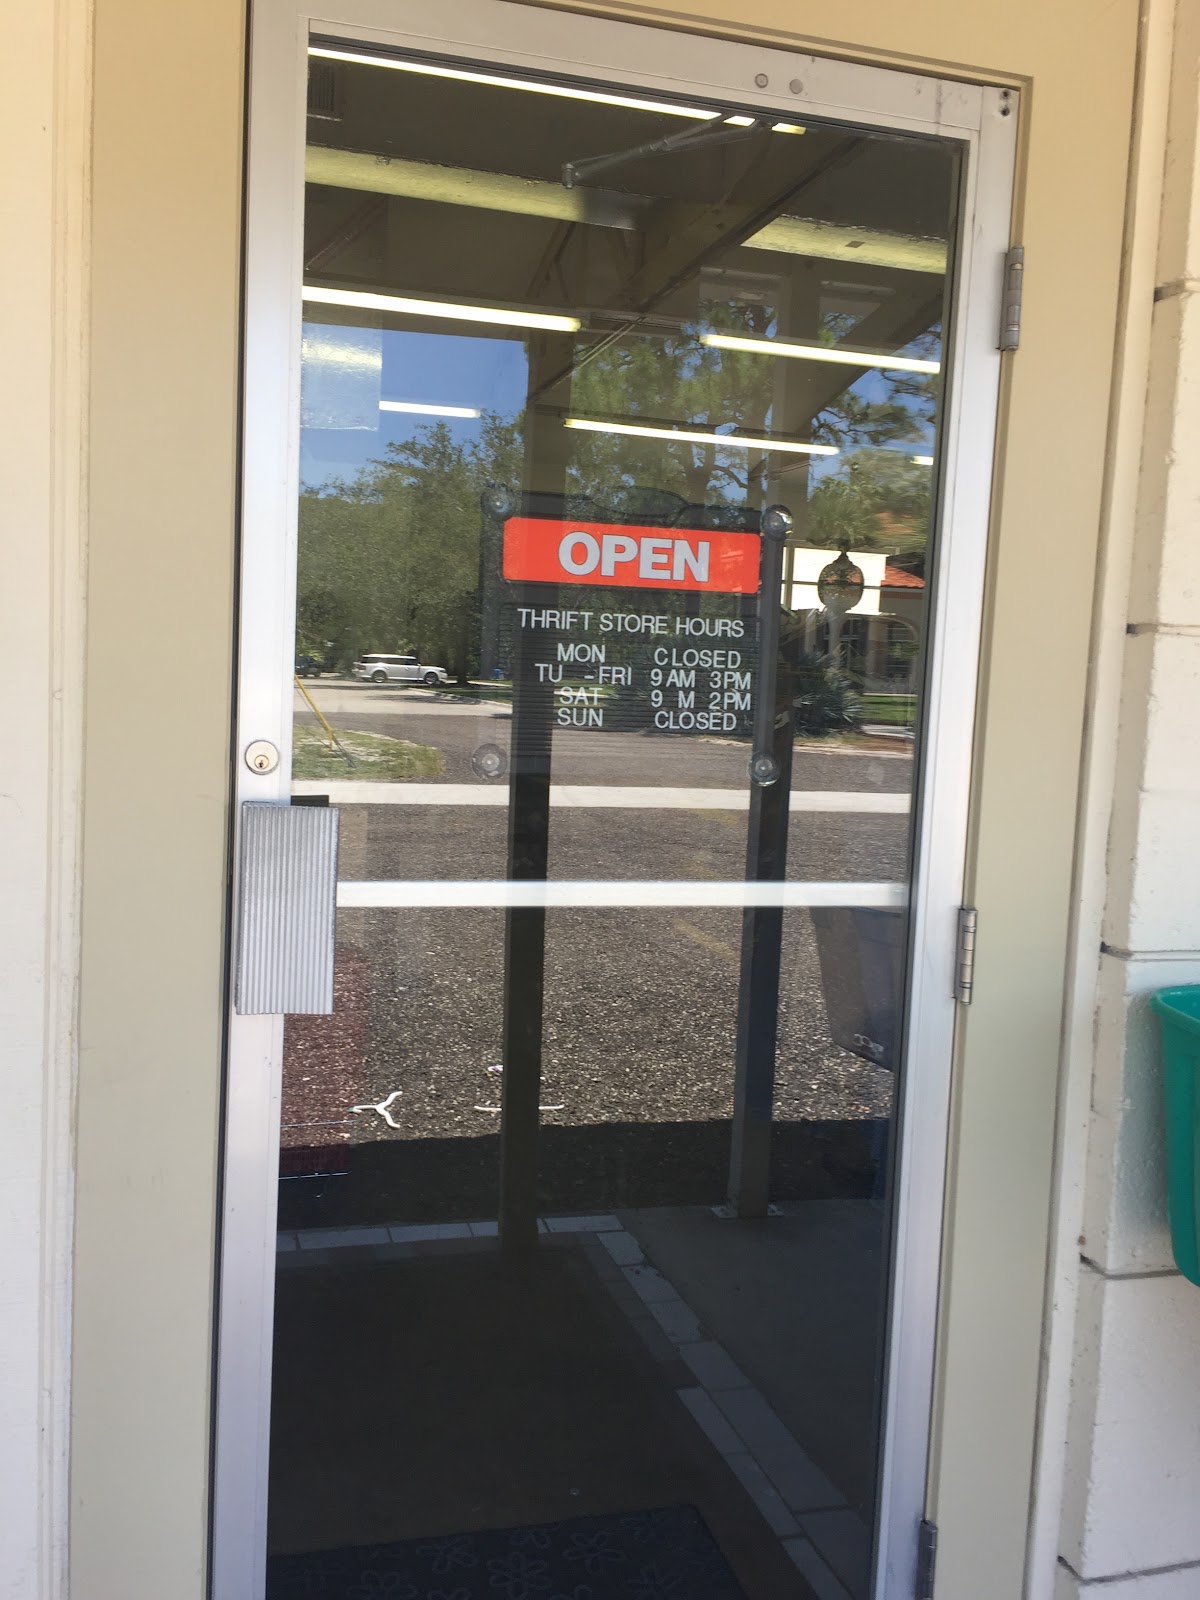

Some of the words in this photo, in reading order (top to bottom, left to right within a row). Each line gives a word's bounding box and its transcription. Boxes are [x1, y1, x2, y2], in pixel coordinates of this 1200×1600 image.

[558, 531, 710, 582] OPEN
[517, 608, 593, 630] THRIFT
[600, 613, 668, 634] STORE
[676, 617, 744, 638] HOURS
[557, 643, 606, 663] MON
[654, 648, 741, 668] CLOSED
[535, 664, 562, 683] TU
[709, 671, 751, 690] 3PM
[559, 687, 602, 706] SAT
[709, 691, 751, 711] 2PM
[557, 708, 603, 726] SUN
[654, 711, 736, 731] CLOSED
